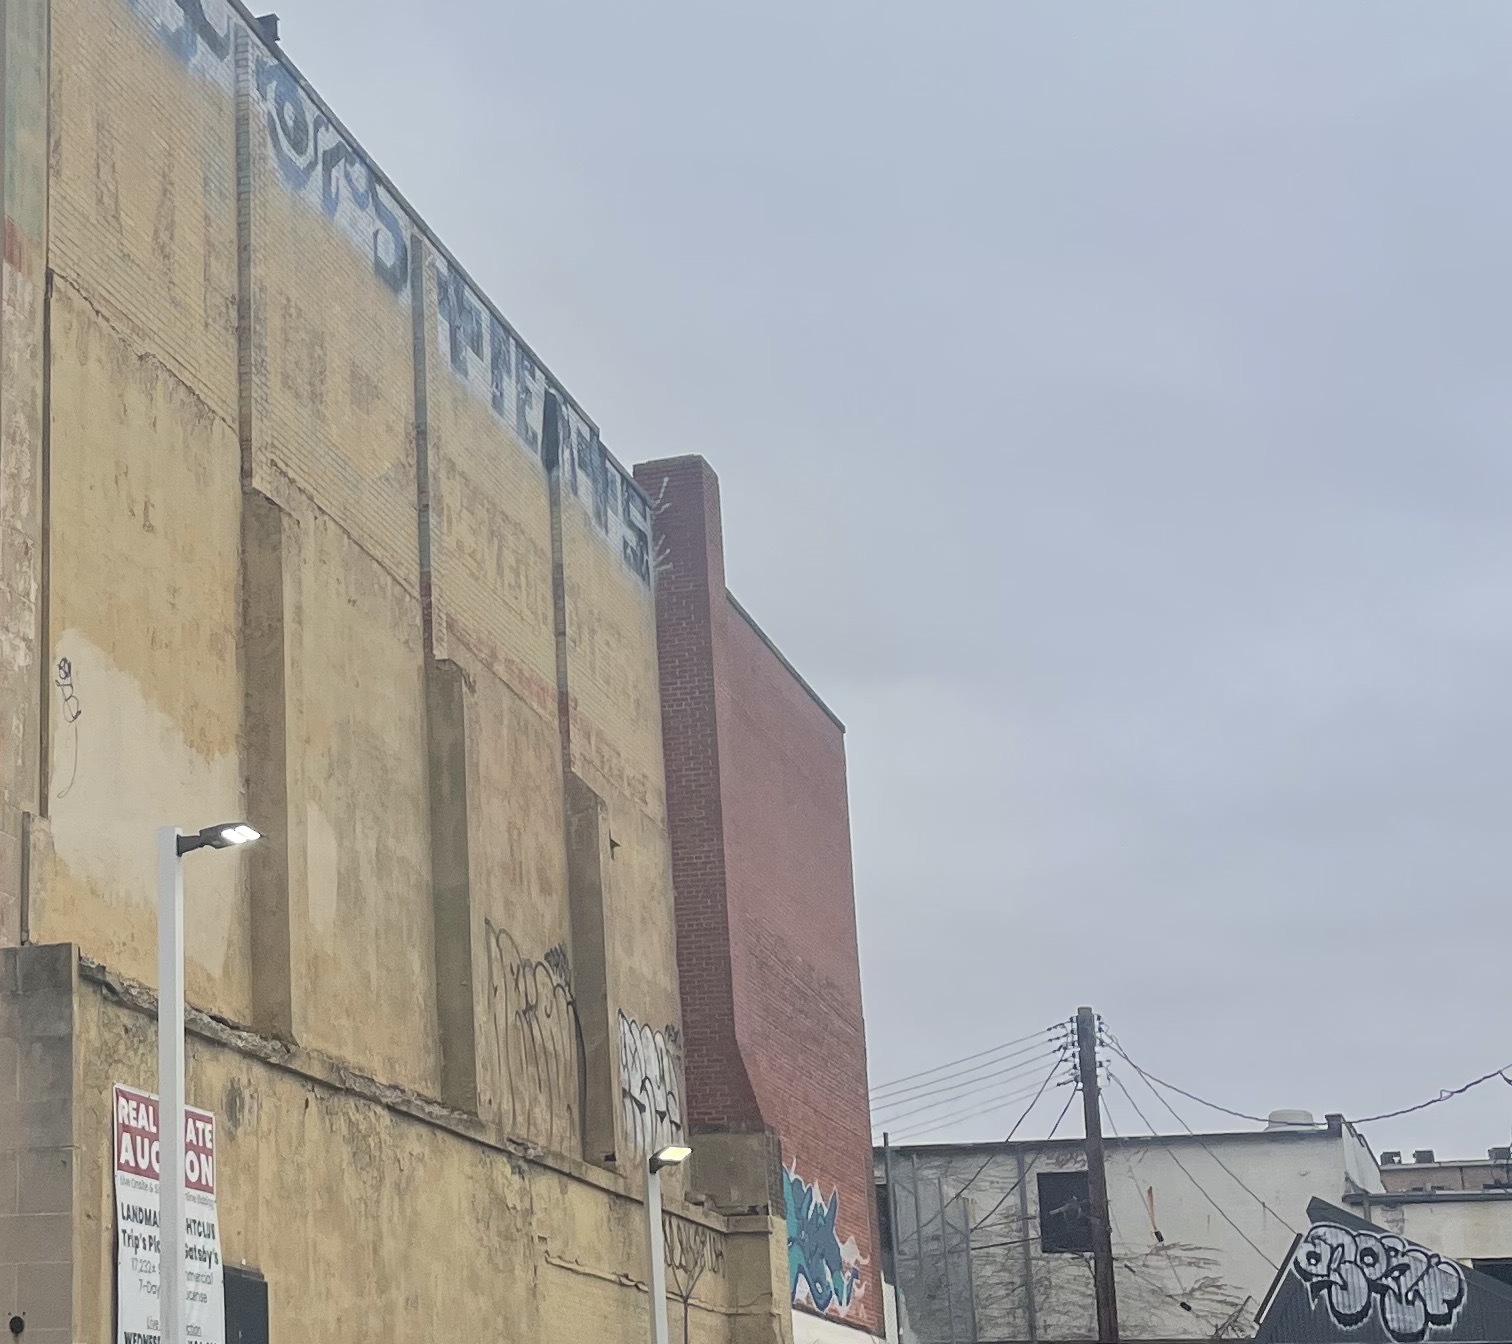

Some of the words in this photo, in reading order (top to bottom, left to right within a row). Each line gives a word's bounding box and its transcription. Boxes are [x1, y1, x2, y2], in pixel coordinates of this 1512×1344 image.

[118, 1096, 157, 1134] REAL
[119, 1132, 214, 1188] AUCON
[121, 1229, 147, 1256] Trip's
